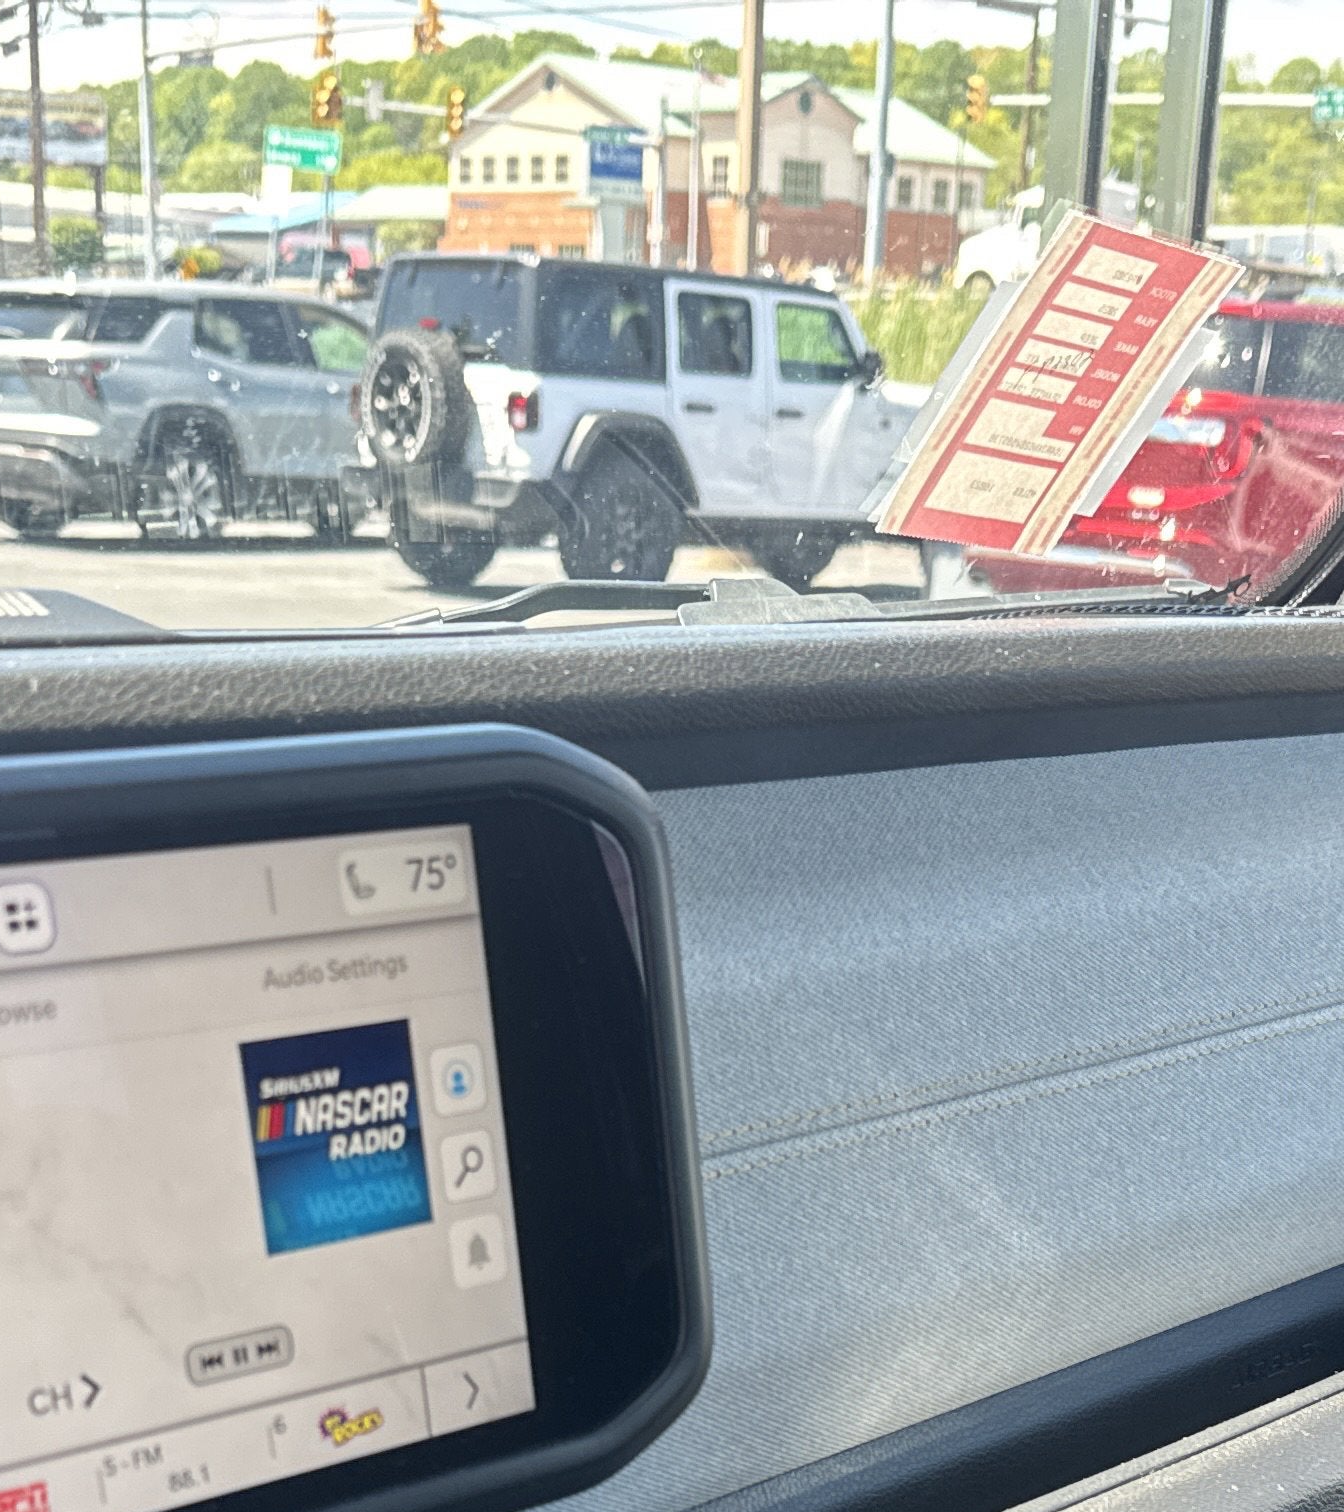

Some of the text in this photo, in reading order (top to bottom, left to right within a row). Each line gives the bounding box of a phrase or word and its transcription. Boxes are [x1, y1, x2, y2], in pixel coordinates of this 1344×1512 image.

[263, 951, 408, 992] Audio Settings
[294, 1081, 409, 1136] NASCAR
[329, 1123, 406, 1160] RADIO
[27, 1383, 76, 1418] CH
